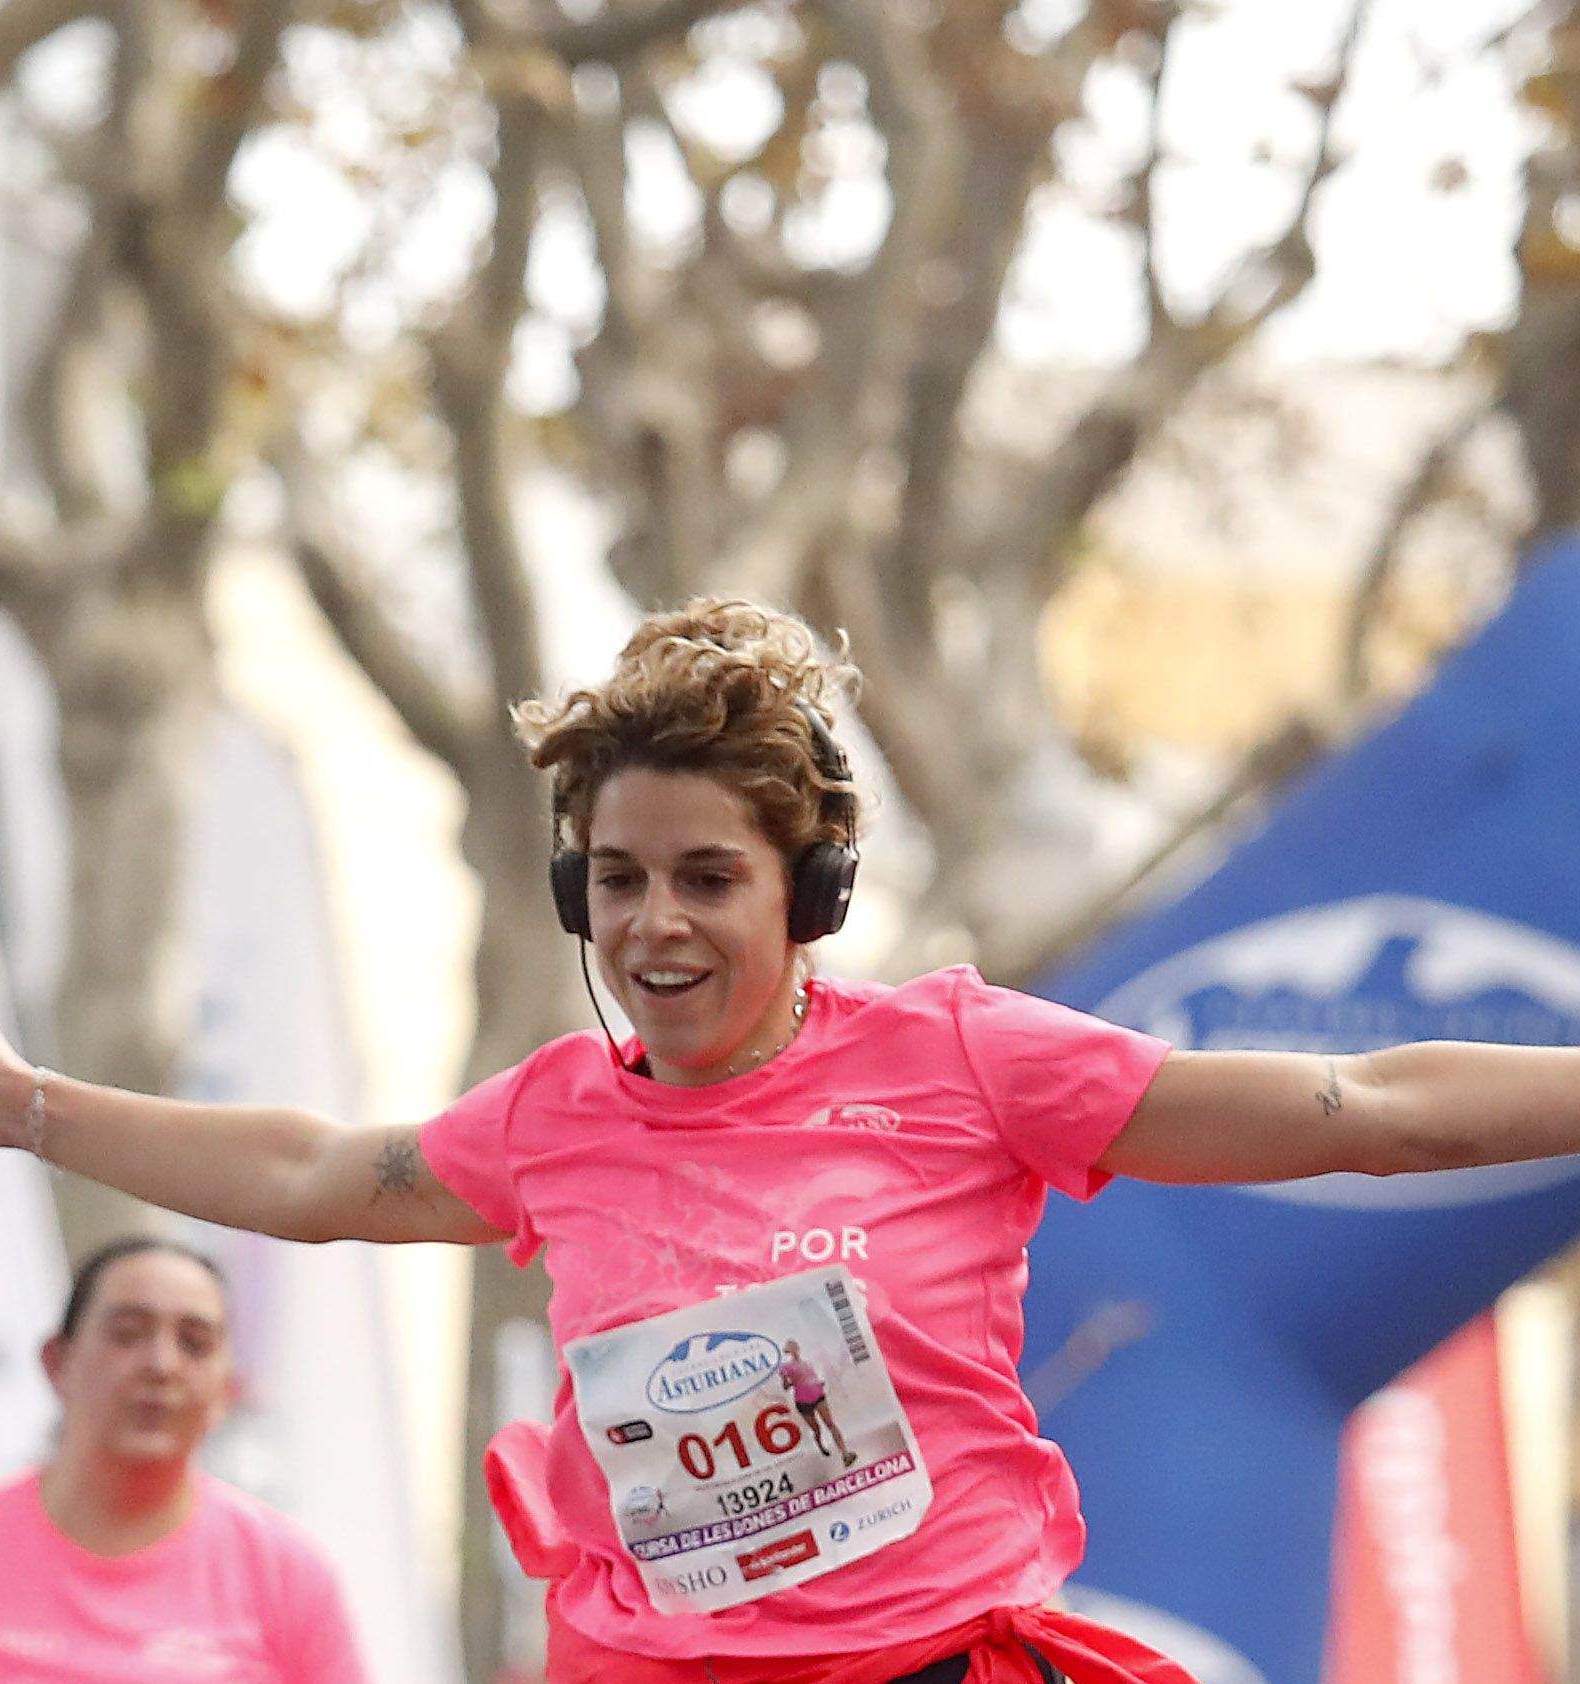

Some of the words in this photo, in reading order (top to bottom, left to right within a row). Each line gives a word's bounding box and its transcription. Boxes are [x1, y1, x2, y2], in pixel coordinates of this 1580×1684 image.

[771, 1226, 869, 1263] POR
[657, 1353, 771, 1402] ASTURIANA
[677, 1404, 801, 1480] 016
[703, 1521, 732, 1542] LES
[733, 1506, 786, 1538] DONES
[813, 1455, 911, 1504] BARCELONA
[717, 1472, 794, 1517] 13924
[857, 1499, 912, 1531] ZURICH
